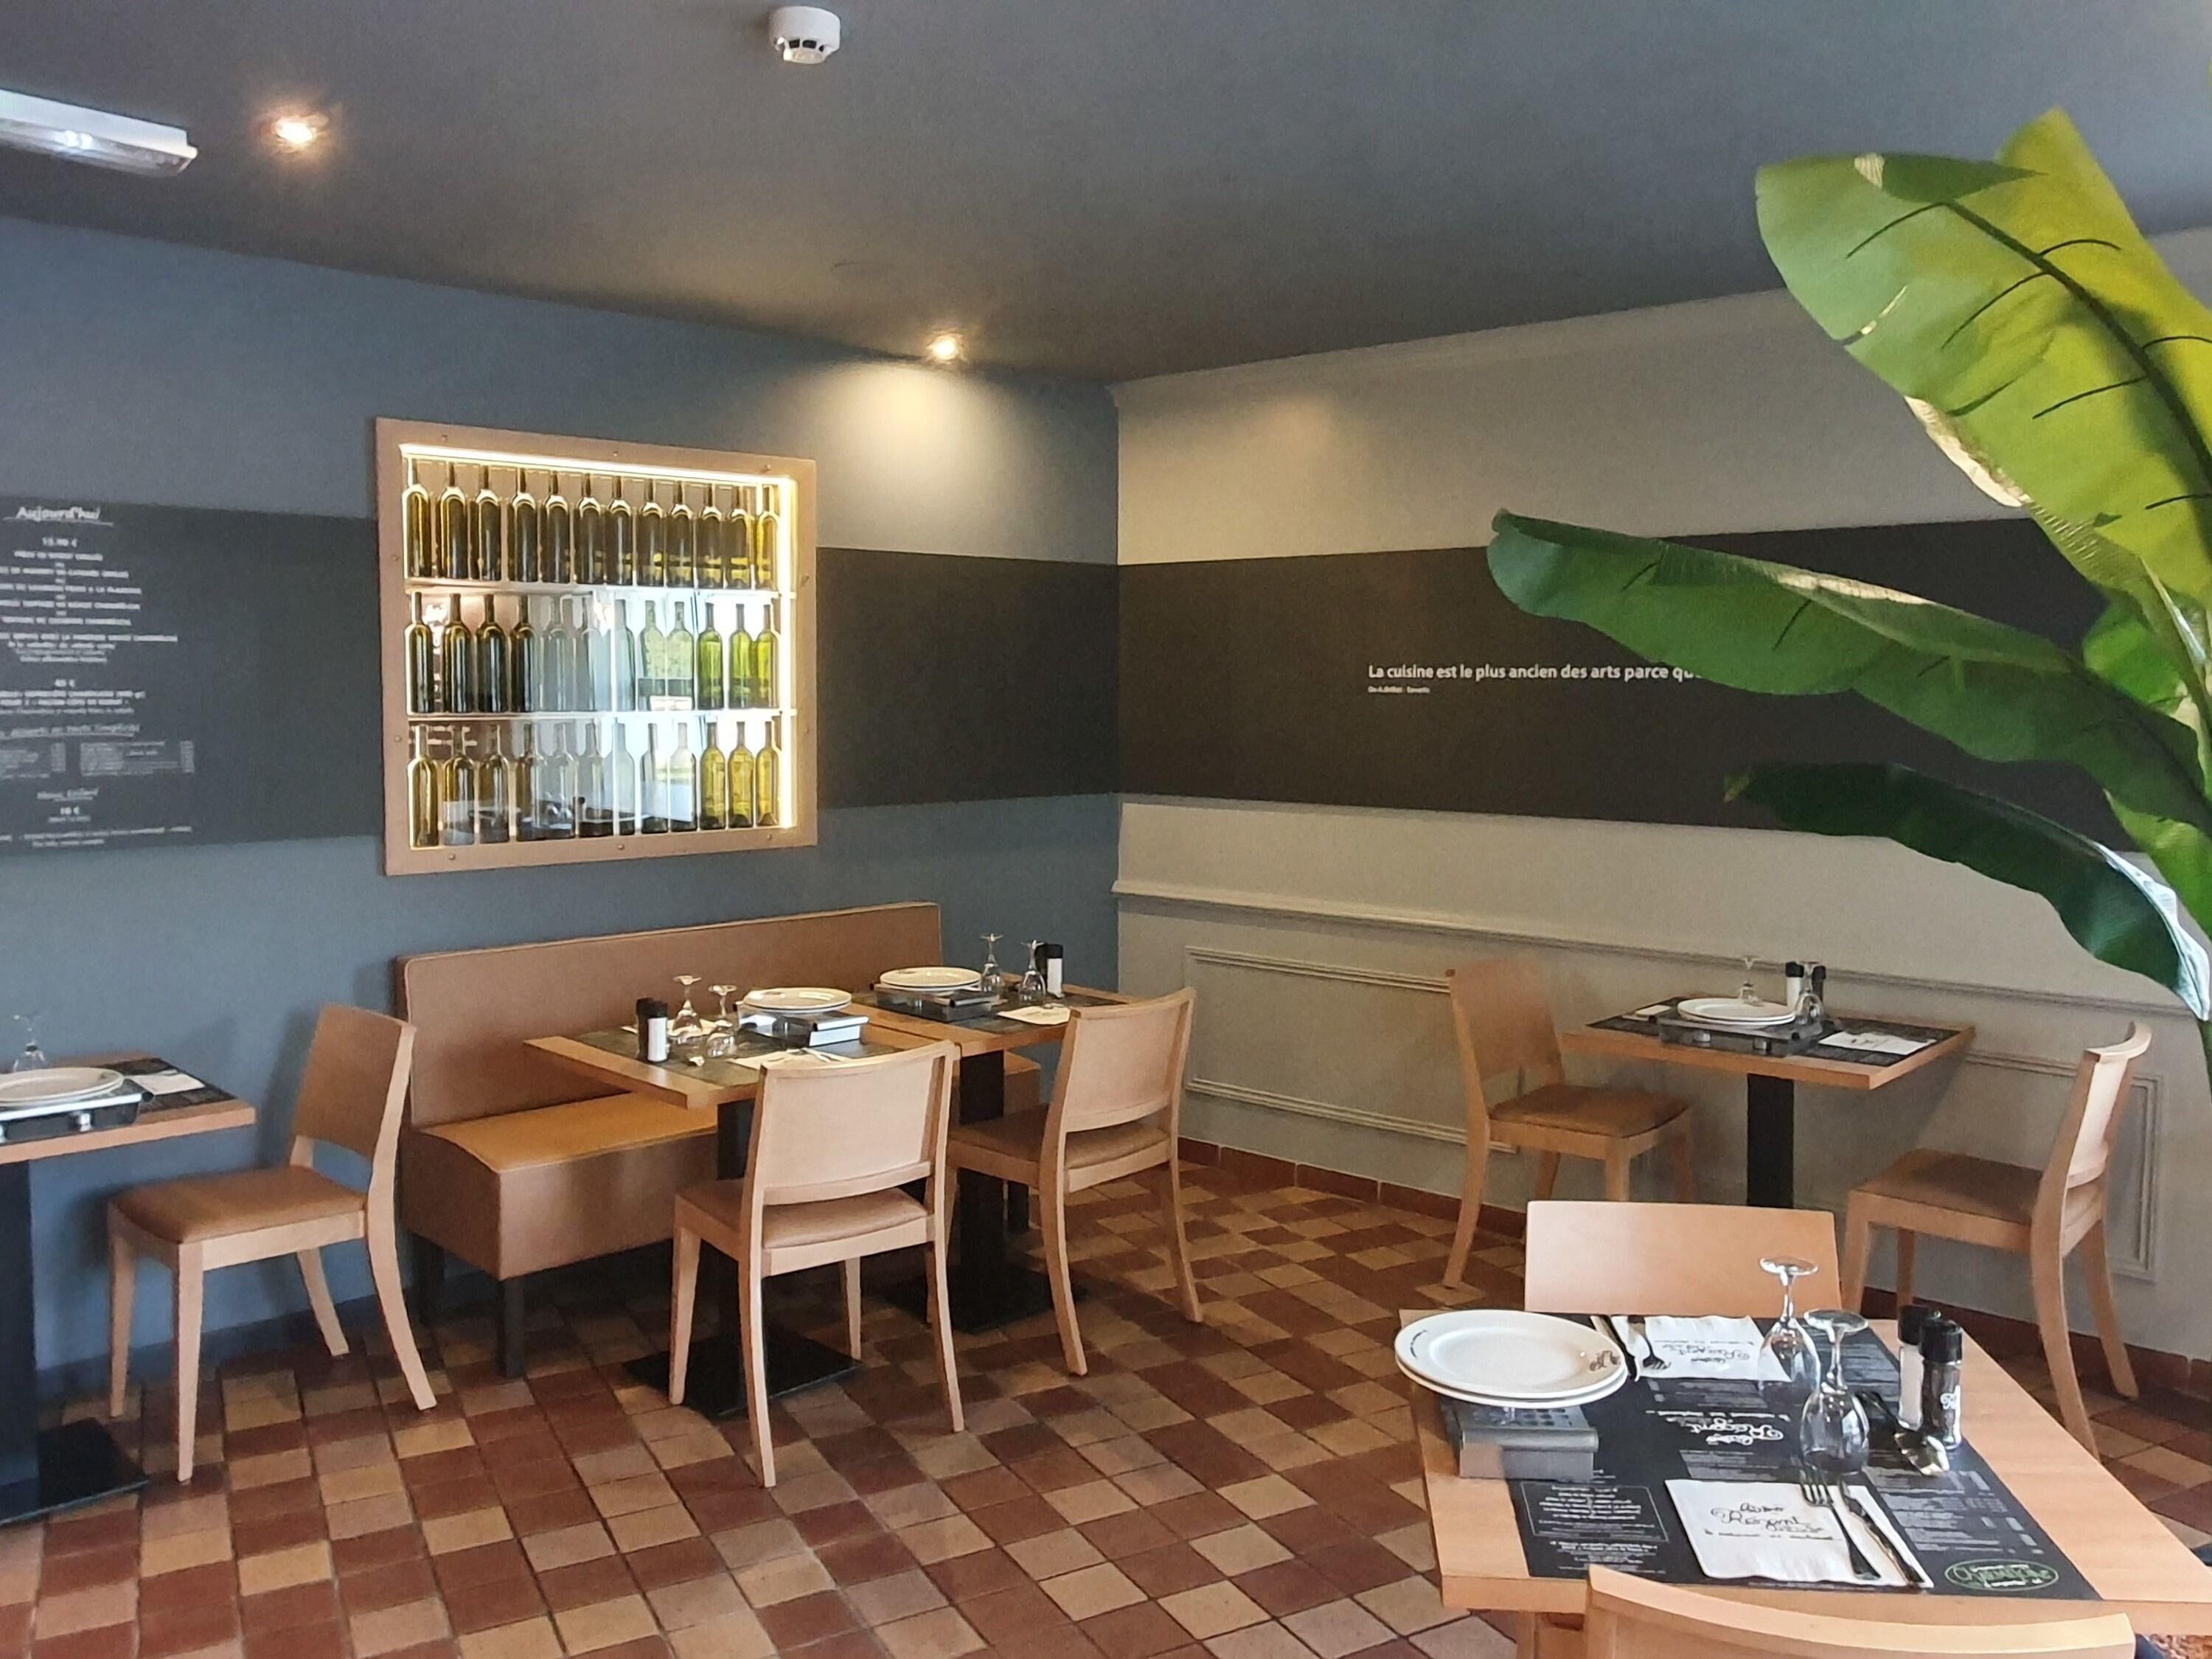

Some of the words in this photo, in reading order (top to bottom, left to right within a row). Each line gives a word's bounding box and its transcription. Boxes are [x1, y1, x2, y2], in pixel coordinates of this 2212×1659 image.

[1368, 664, 1385, 678] La
[1386, 664, 1434, 678] cuisine
[1436, 665, 1458, 678] est
[1459, 664, 1473, 678] le
[1475, 664, 1506, 682] plus
[1508, 664, 1557, 678] ancien
[1560, 664, 1587, 678] des
[1590, 665, 1621, 678] arts
[1624, 666, 1669, 682] parce
